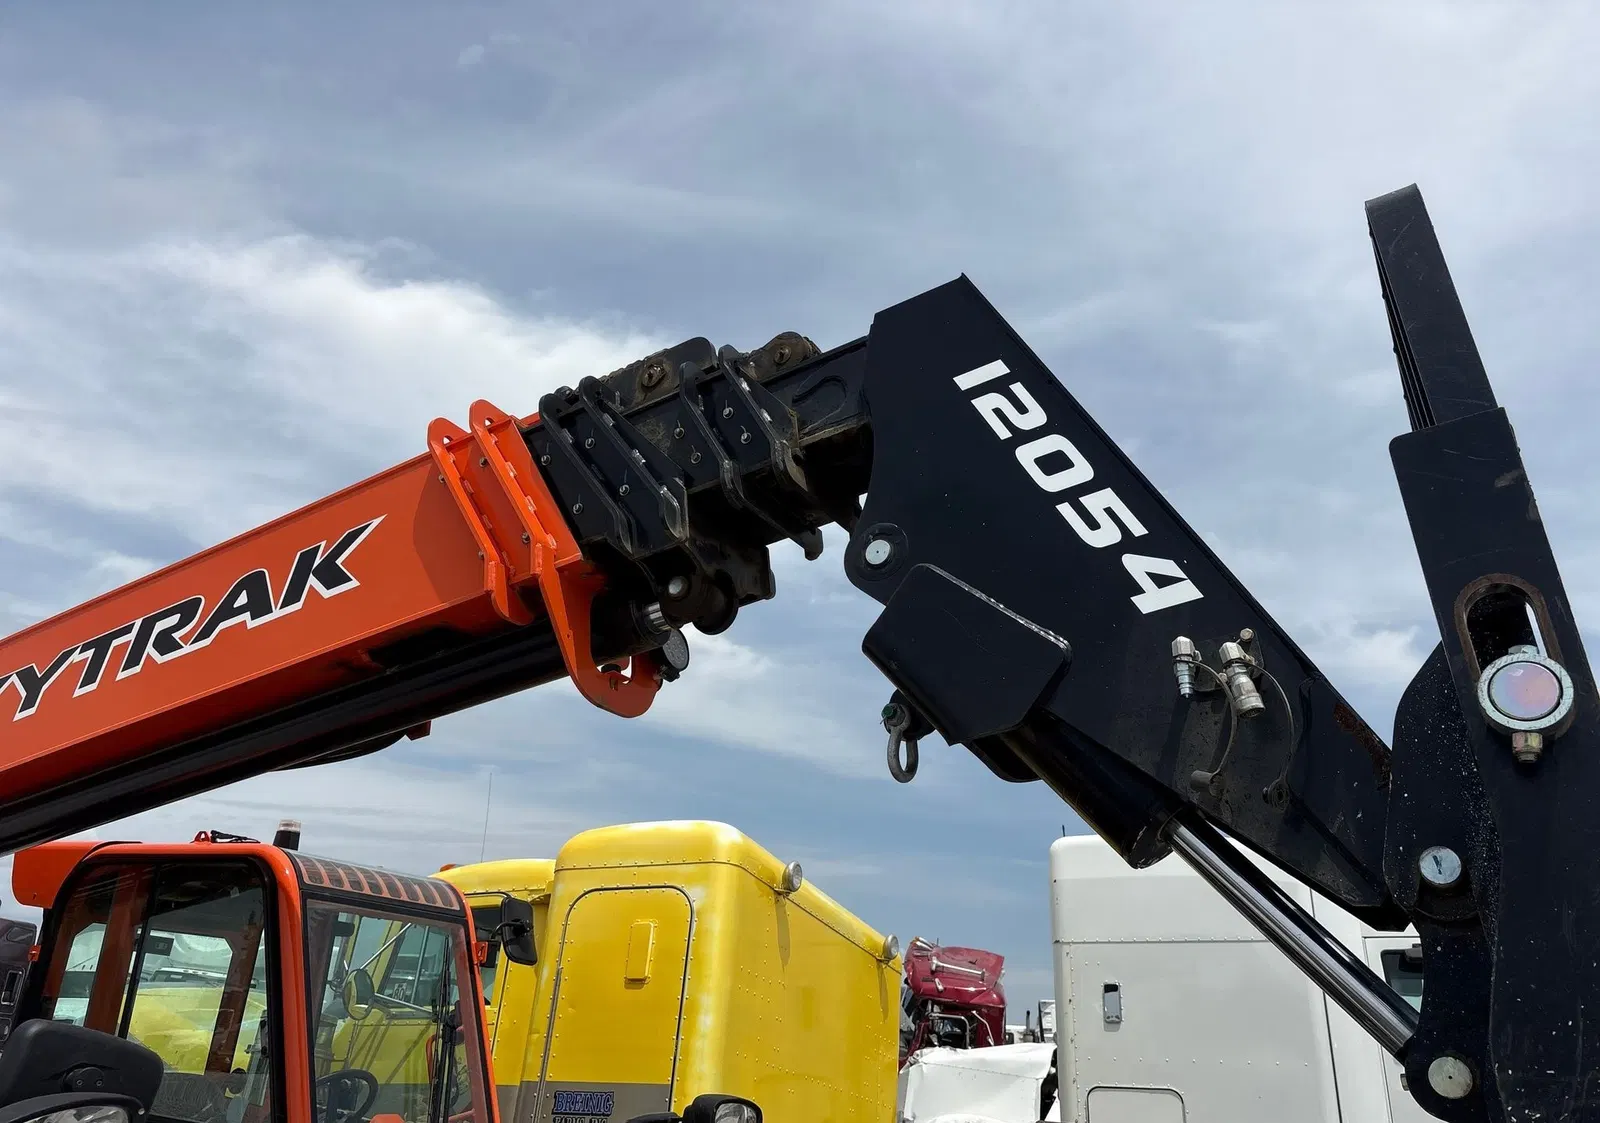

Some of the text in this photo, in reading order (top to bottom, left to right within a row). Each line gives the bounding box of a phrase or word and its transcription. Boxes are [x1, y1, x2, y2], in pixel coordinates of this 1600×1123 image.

[952, 359, 1204, 614] 12054
[0, 514, 387, 721] YTRAK
[552, 1091, 614, 1115] BREINIG
